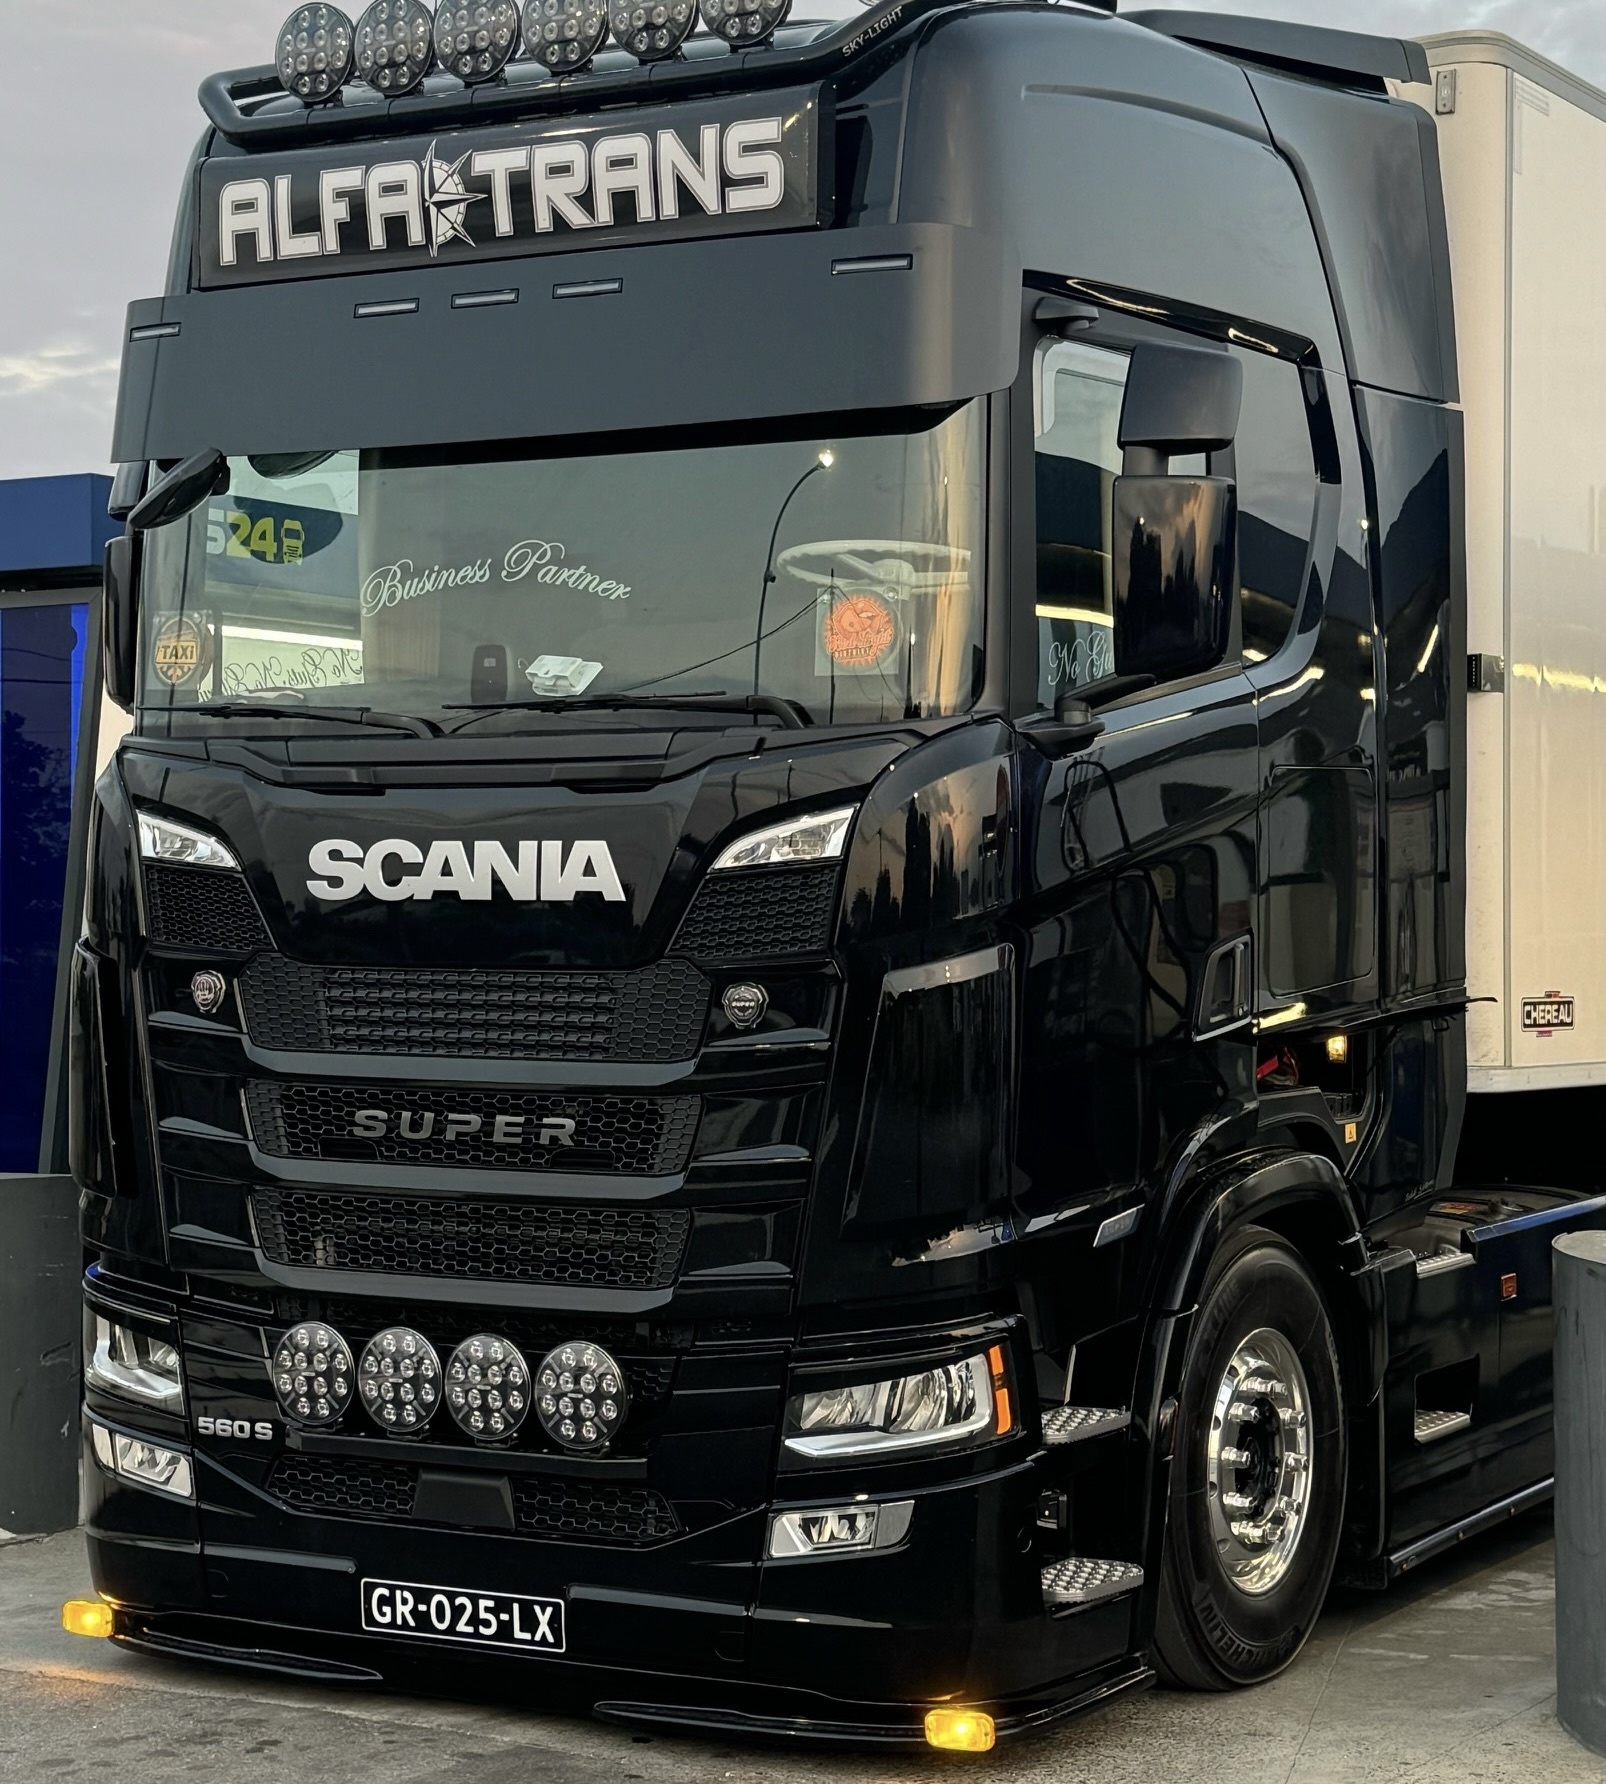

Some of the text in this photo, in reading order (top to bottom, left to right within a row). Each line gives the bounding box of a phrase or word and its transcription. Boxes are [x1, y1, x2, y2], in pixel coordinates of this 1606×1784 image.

[842, 6, 902, 57] SKY-LIGHT
[219, 117, 784, 266] ALFA TRANS
[360, 539, 632, 617] Business Partner
[1048, 638, 1087, 686] No
[307, 839, 626, 902] SCANIA
[1524, 1003, 1573, 1025] CHEREAU
[352, 1109, 577, 1146] SUPER
[198, 1416, 273, 1440] 560 S
[371, 1587, 555, 1643] GR-025-LX
